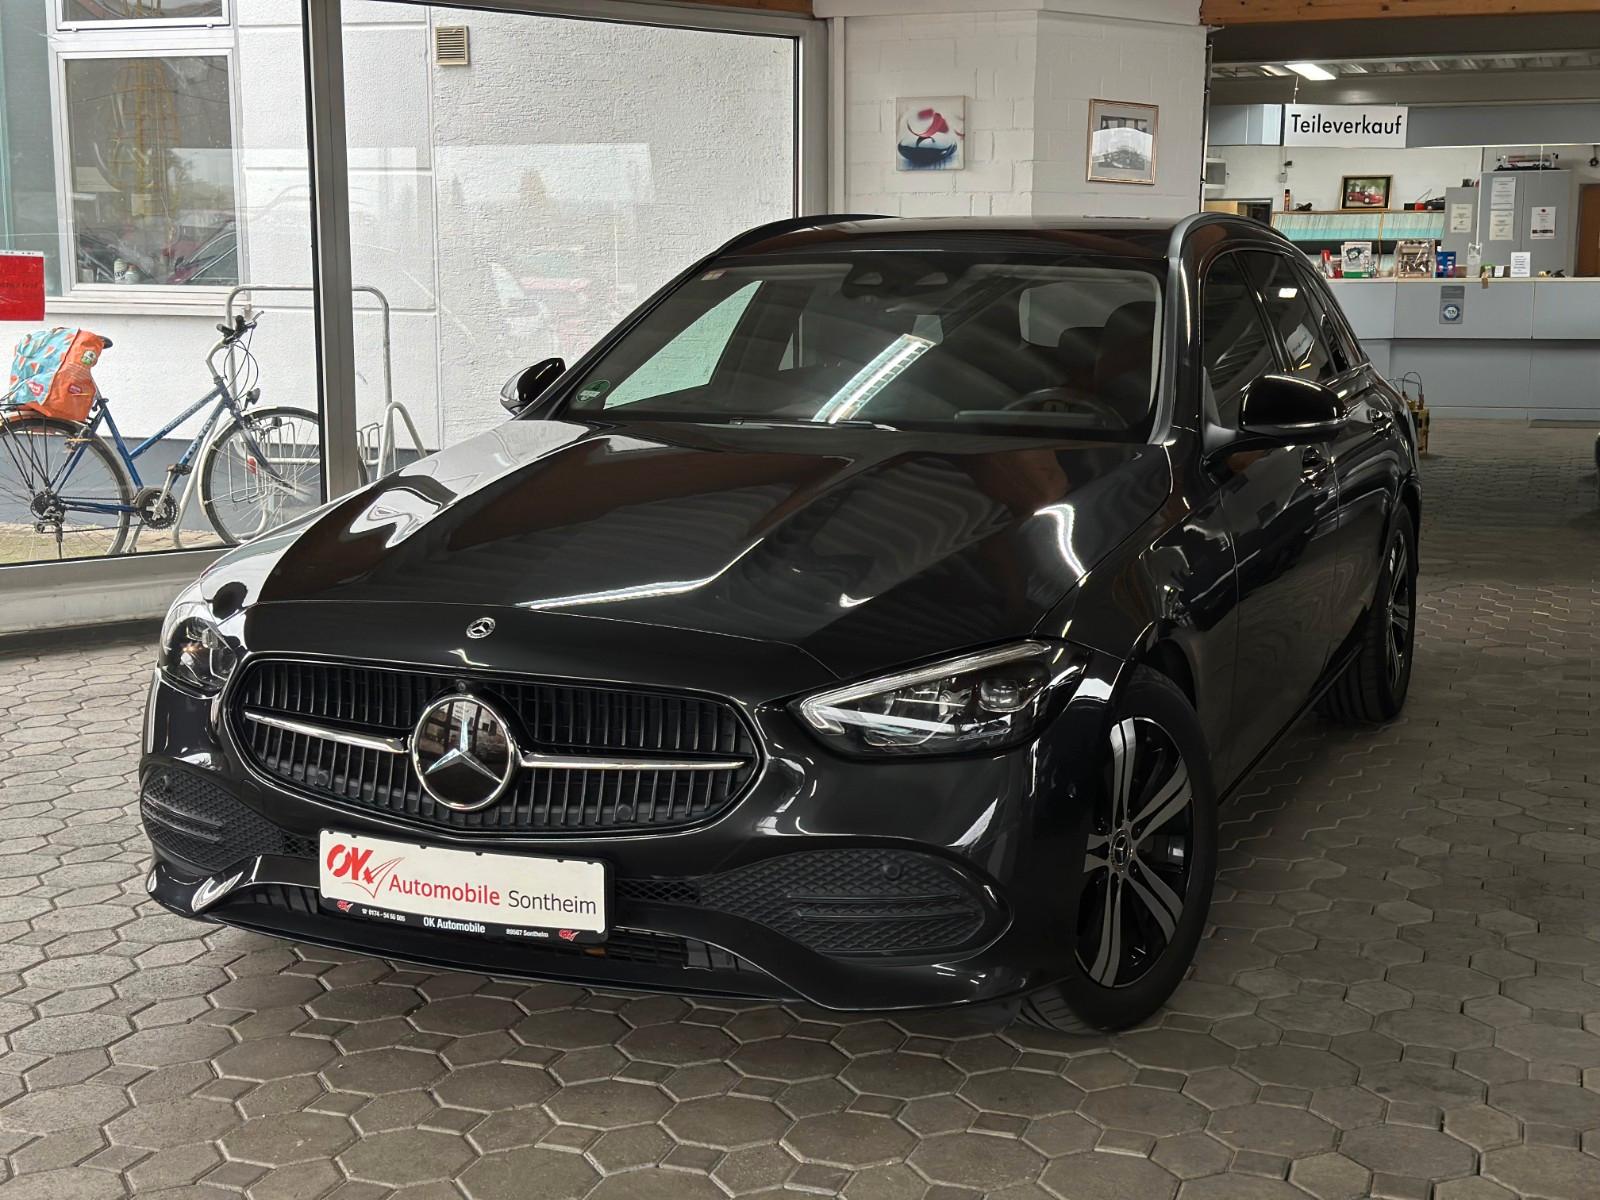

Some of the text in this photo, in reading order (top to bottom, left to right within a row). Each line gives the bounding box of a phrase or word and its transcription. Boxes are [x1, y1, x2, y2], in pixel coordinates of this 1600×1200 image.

[1291, 113, 1402, 134] Teileverkauf
[327, 844, 374, 884] OK
[388, 874, 597, 914] Automobile Sontheim
[423, 917, 486, 933] OK Automobile
[523, 930, 549, 938] Sontheim
